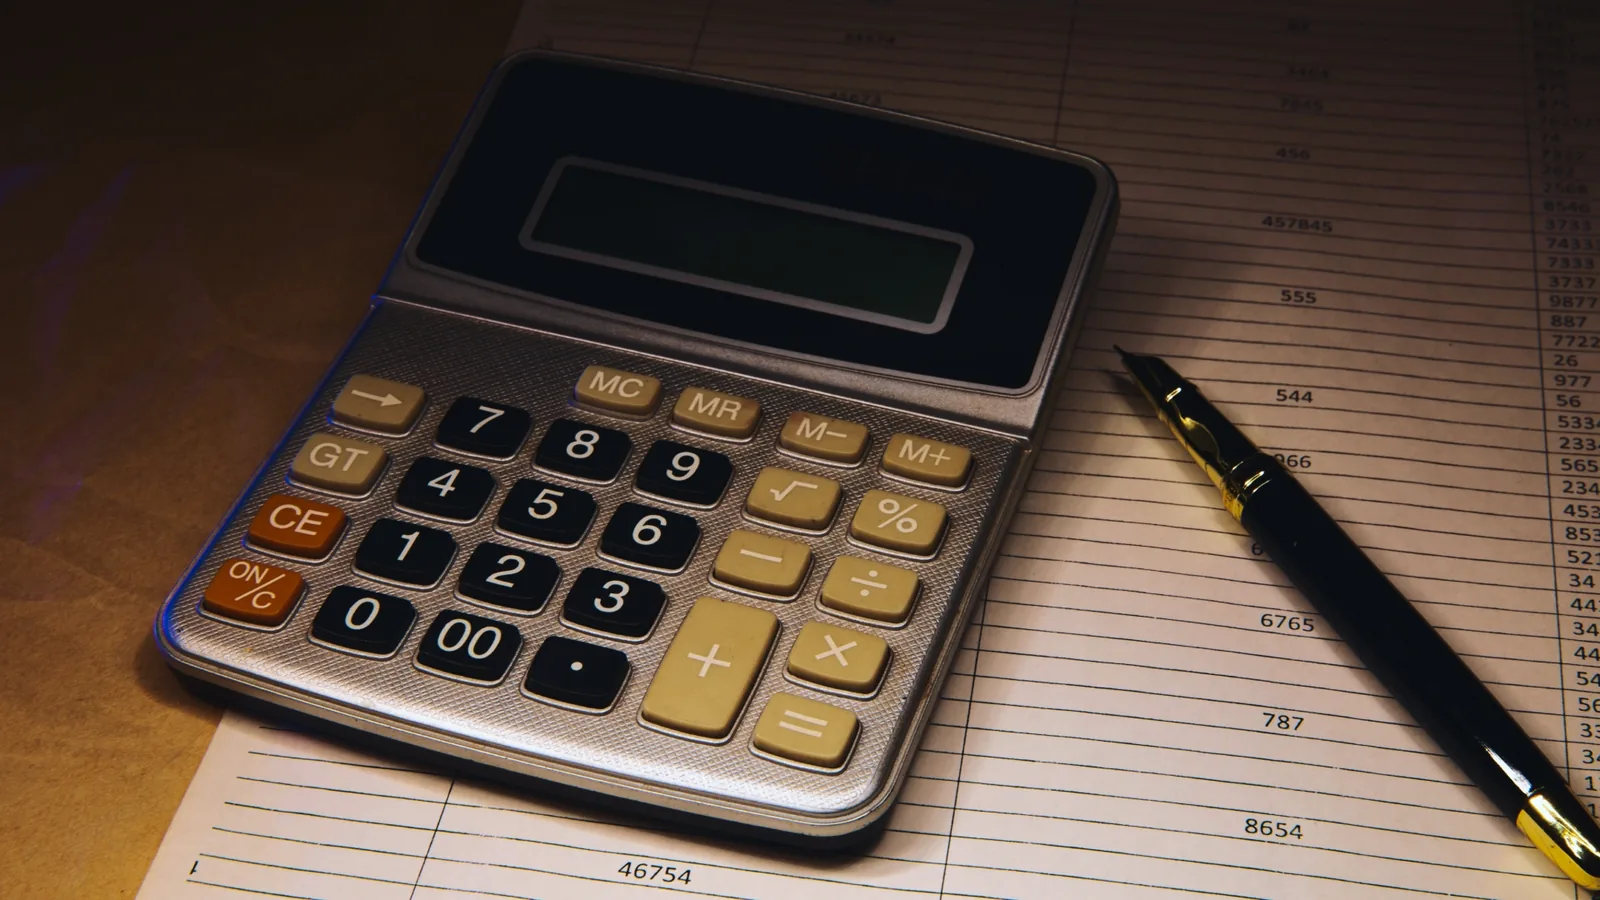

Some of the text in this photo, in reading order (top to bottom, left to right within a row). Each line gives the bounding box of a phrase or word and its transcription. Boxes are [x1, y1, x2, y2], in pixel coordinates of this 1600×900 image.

[1261, 215, 1333, 234] 457845
[1548, 275, 1597, 289] 3737
[1280, 289, 1318, 304] 555
[1549, 294, 1598, 309] 9877
[1550, 314, 1588, 328] 887
[1551, 334, 1600, 348] 7722
[1553, 354, 1579, 368] 26
[587, 369, 645, 400] MC
[1554, 374, 1592, 388] 977
[1275, 388, 1314, 404] 544
[1555, 394, 1582, 408] 56
[686, 392, 743, 422] MR
[469, 405, 505, 435] 7
[565, 429, 602, 461] 8
[896, 438, 953, 467] M+
[1559, 436, 1600, 452] 233
[308, 442, 369, 473] GT
[665, 451, 702, 482] 9
[1560, 458, 1600, 473] 565
[427, 468, 461, 498] 4
[1562, 480, 1600, 496] 234
[527, 488, 565, 521] 5
[268, 503, 330, 537] CE
[631, 513, 668, 547] 6
[396, 530, 421, 562] 1
[485, 554, 526, 589] 2
[1568, 573, 1596, 589] 34
[593, 579, 631, 614] 3
[1570, 597, 1600, 613] 44
[344, 597, 380, 630] 0
[1260, 613, 1315, 633] 6765
[1572, 620, 1600, 637] 34
[436, 618, 502, 660] 00
[1573, 645, 1600, 662] 44
[1262, 712, 1304, 731] 787
[1584, 775, 1600, 791] 1
[1244, 818, 1304, 840] 8654
[617, 861, 692, 885] 46754
